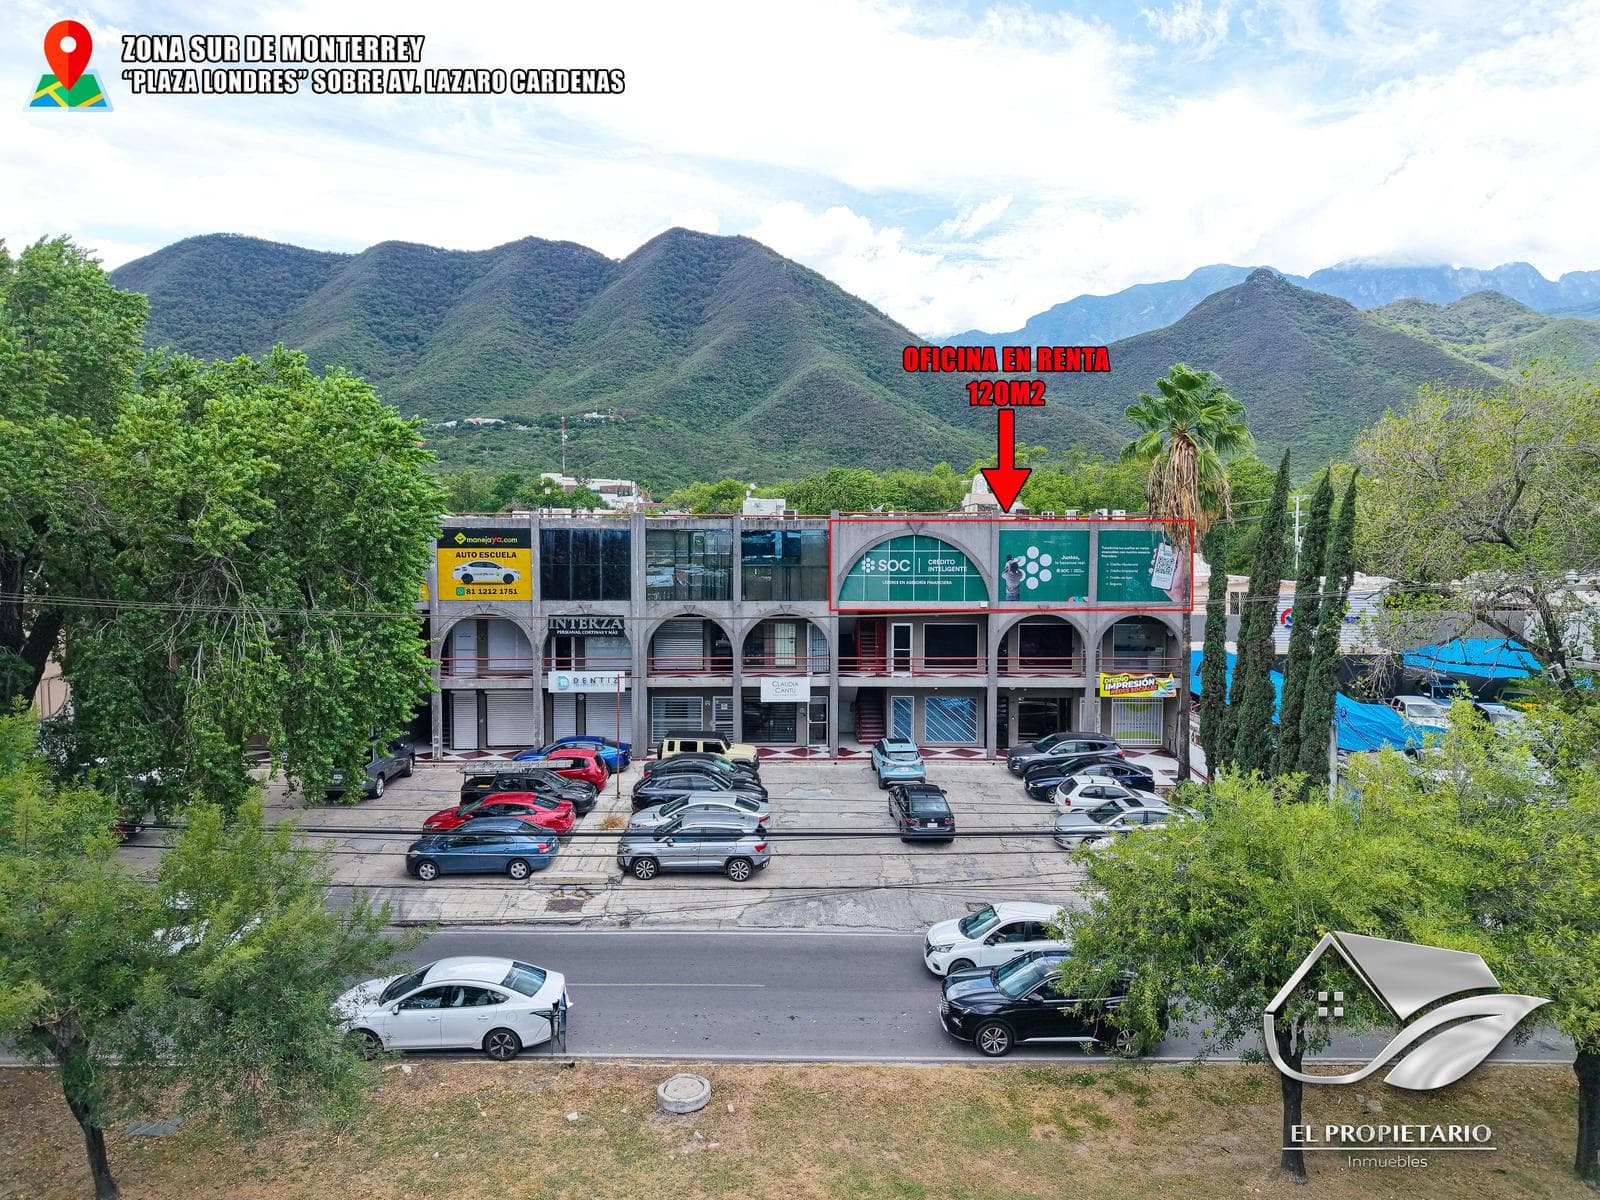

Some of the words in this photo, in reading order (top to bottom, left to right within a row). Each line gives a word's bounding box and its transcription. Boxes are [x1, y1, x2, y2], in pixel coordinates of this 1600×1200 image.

[466, 535, 518, 545] manejaya.com
[878, 559, 911, 571] SOC
[549, 617, 623, 629] INTERZA
[1104, 676, 1129, 684] DISEÑO
[1104, 678, 1155, 690] IMPRESIÓN
